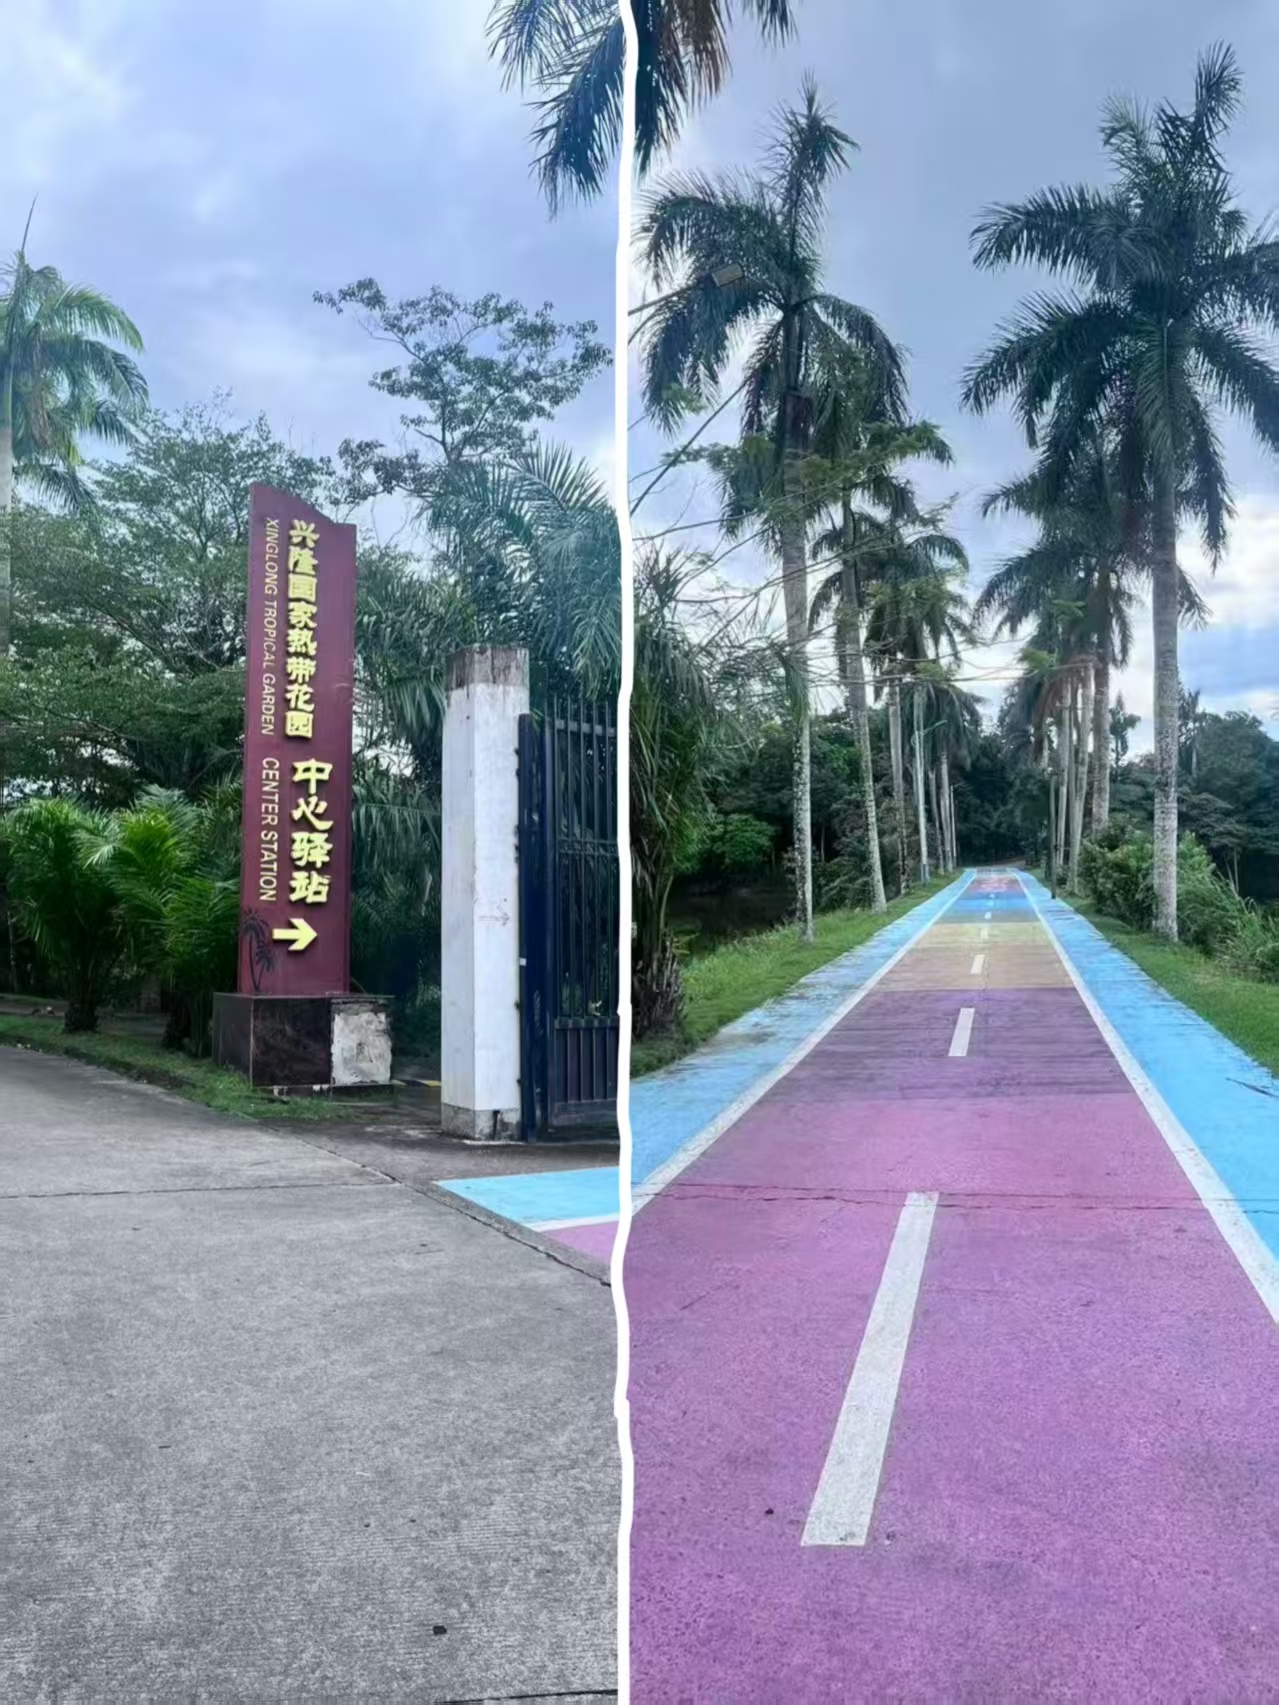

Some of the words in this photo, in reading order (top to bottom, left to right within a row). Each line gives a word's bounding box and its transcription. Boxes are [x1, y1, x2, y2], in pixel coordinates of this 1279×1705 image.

[264, 517, 279, 596] XINGLONG
[263, 600, 277, 668] TROPICAL
[262, 674, 276, 736] GARDEN
[261, 758, 279, 825] CENTER
[289, 758, 333, 903] 中心驿站
[260, 830, 278, 901] STATION
